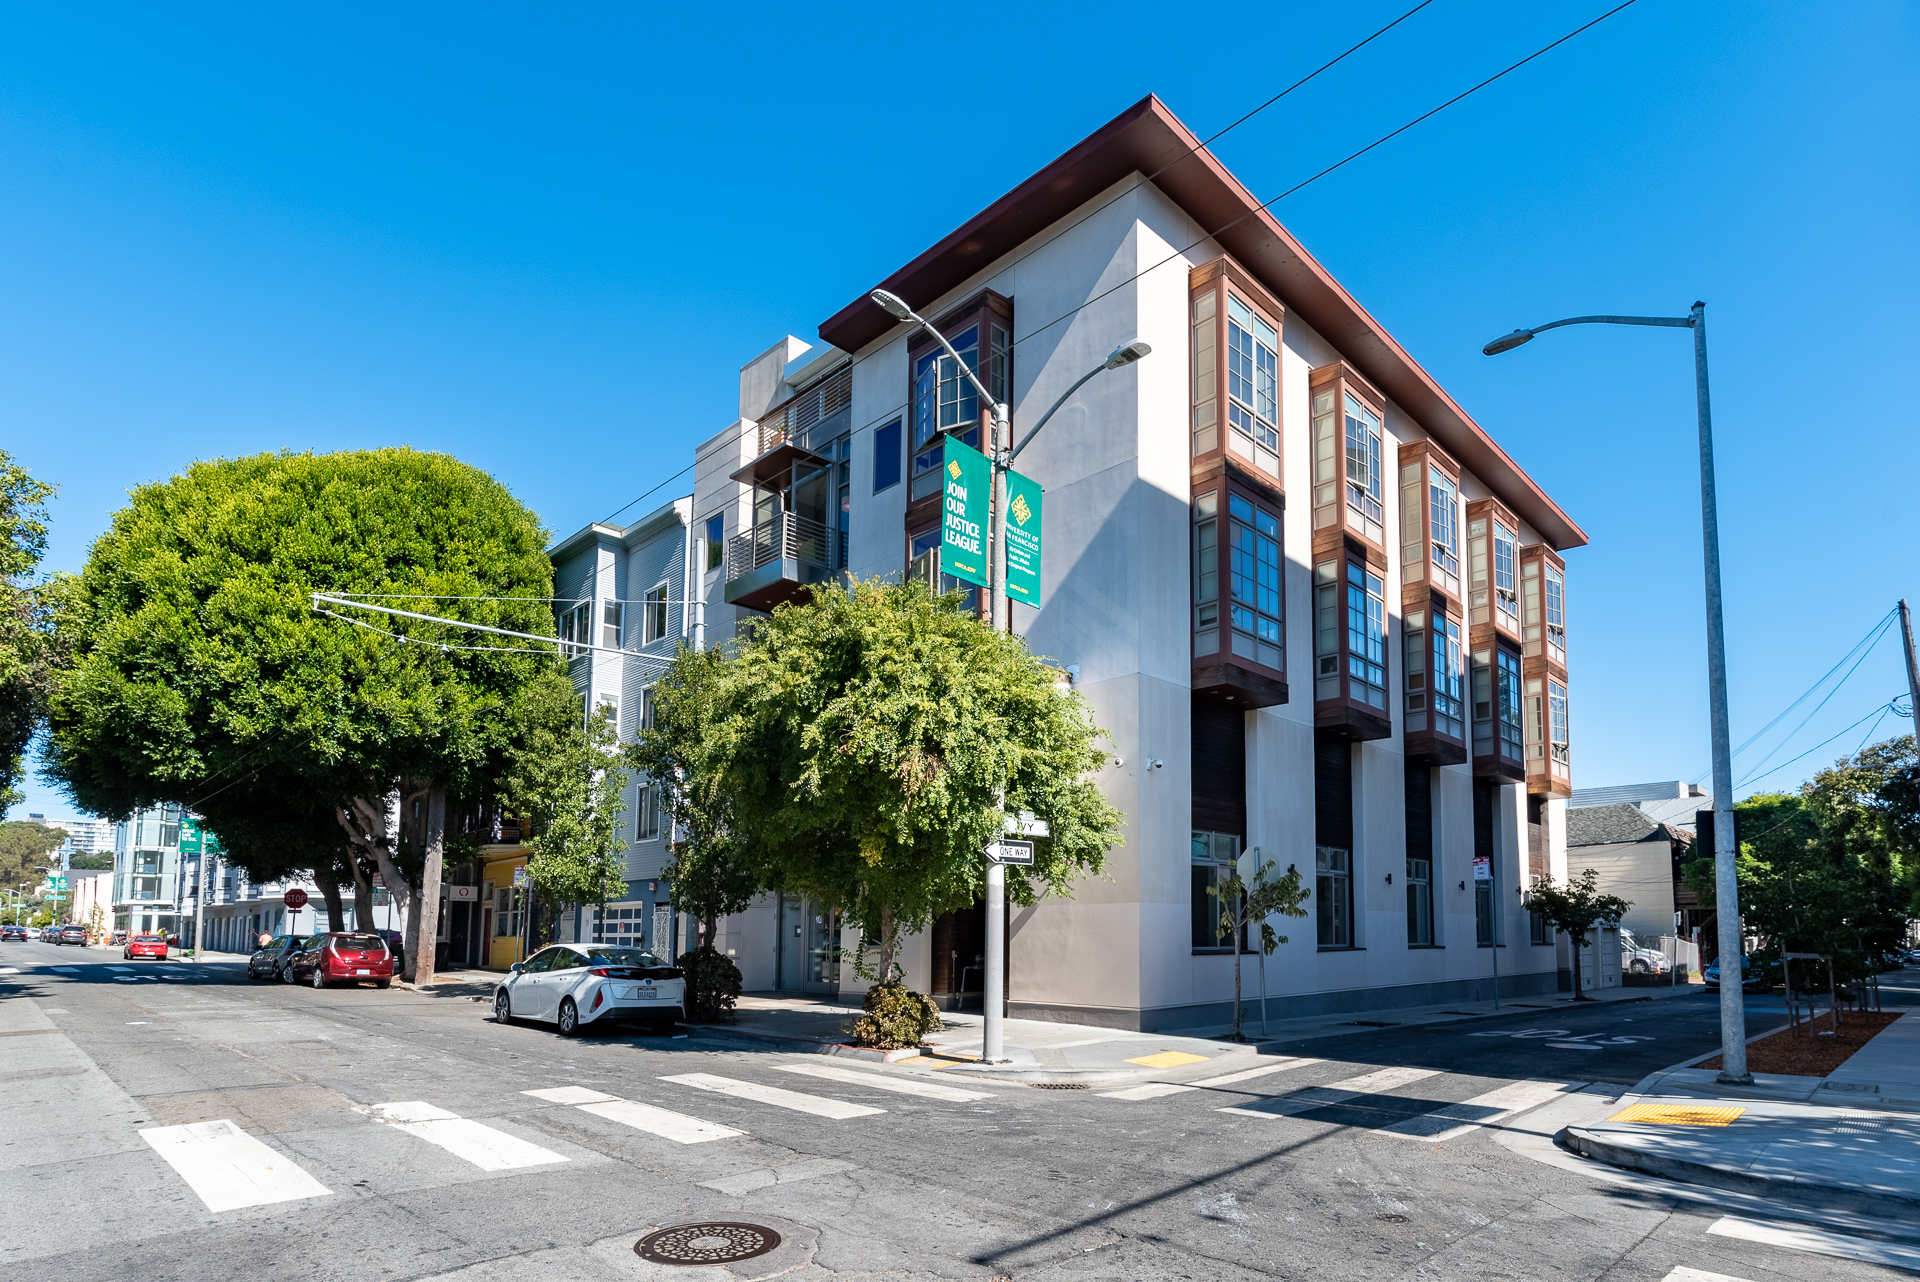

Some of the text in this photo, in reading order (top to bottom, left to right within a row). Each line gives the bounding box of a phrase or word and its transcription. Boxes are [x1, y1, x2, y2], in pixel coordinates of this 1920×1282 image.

[947, 481, 967, 502] JOIN
[946, 497, 966, 517] OUR
[945, 513, 980, 539] JUSTICE
[1006, 522, 1039, 544] NIVERSITY OF
[945, 528, 982, 556] LEAGUE.
[1011, 534, 1039, 552] FRANCISCO
[1000, 846, 1028, 857] ONE WAY
[286, 894, 306, 903] STOP
